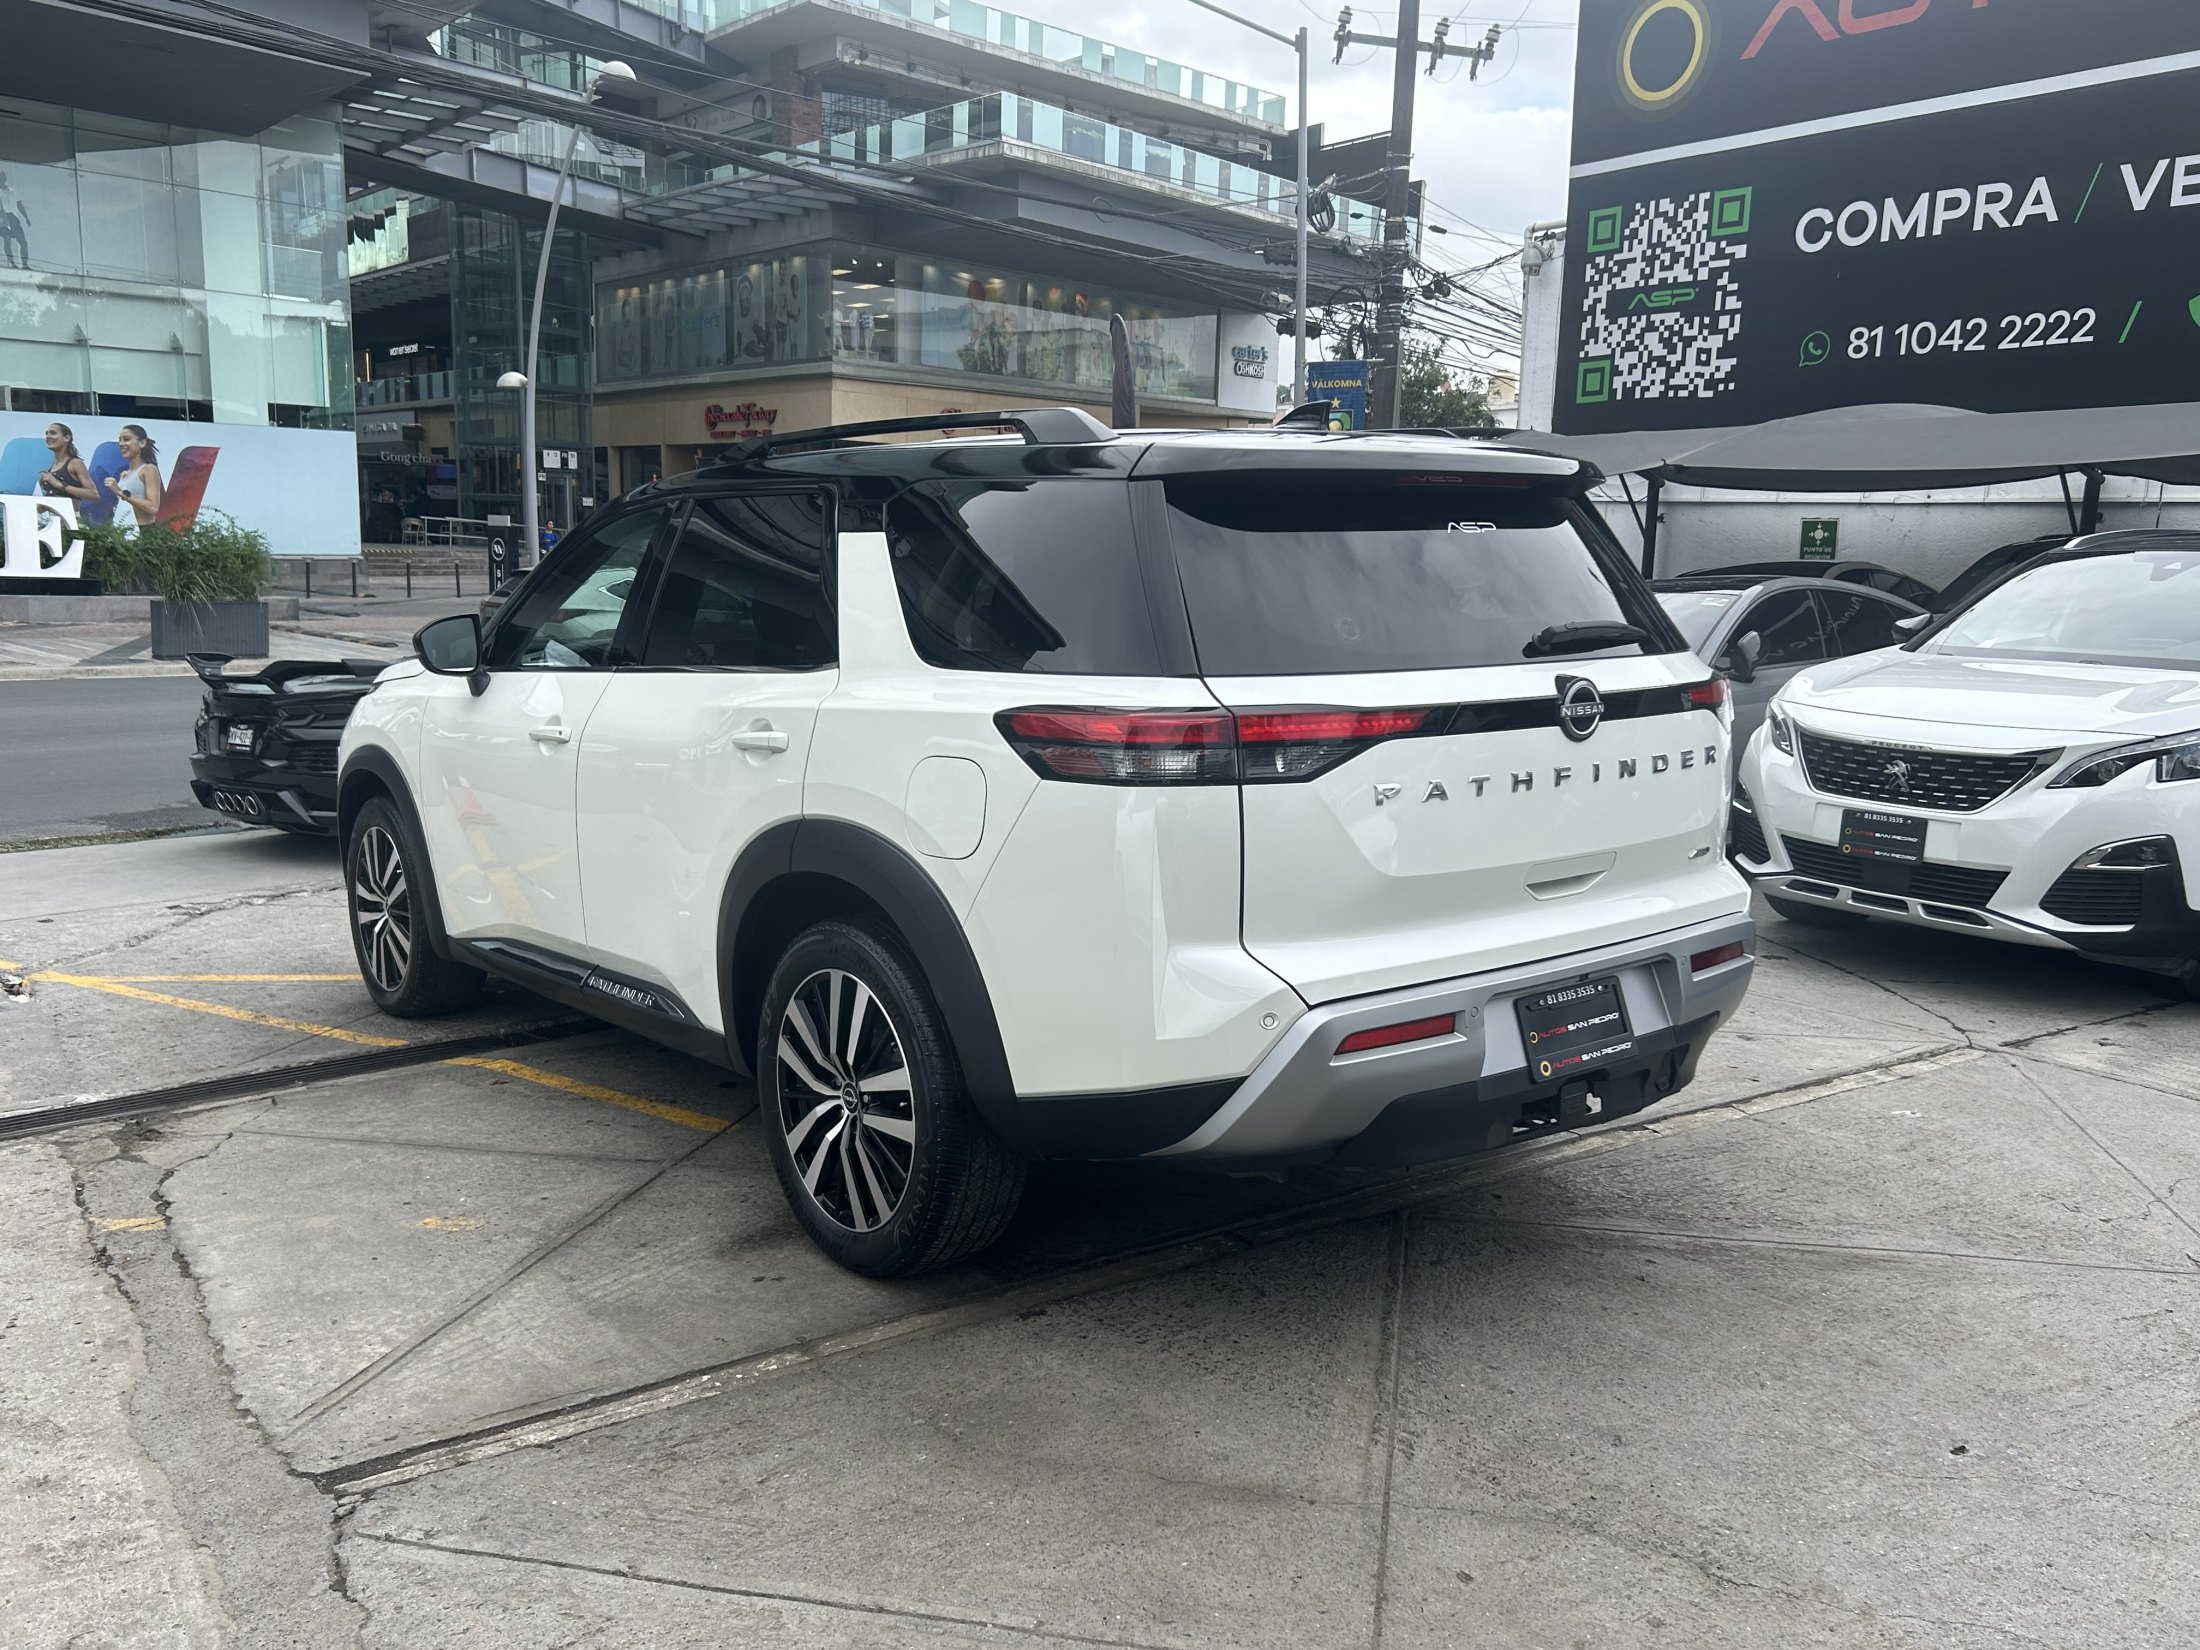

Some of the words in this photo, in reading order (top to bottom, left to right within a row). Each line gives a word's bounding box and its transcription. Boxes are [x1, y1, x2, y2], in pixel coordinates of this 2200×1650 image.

[1794, 176, 2059, 253] COMPRA
[1628, 288, 1696, 310] ASP
[1847, 326, 1884, 359] 81
[1894, 318, 1988, 355] 1042
[1997, 307, 2097, 349] 2222
[381, 451, 411, 465] Gong
[412, 453, 432, 464] cha
[1447, 522, 1497, 533] ASP
[1561, 704, 1605, 717] NISSAN
[1871, 740, 1924, 751] PEUGEOT
[1373, 745, 1717, 807] PATHFINDER
[1546, 994, 1557, 1005] 81
[1557, 990, 1577, 1002] 8335
[1577, 985, 1595, 998] 3535
[1538, 1026, 1568, 1039] AUTOS
[1567, 1020, 1588, 1031] SAN
[1588, 1012, 1619, 1026] PEDRO
[1552, 1055, 1582, 1069] AUTOS
[1581, 1050, 1601, 1061] SAN
[1601, 1042, 1632, 1056] PEDRO
